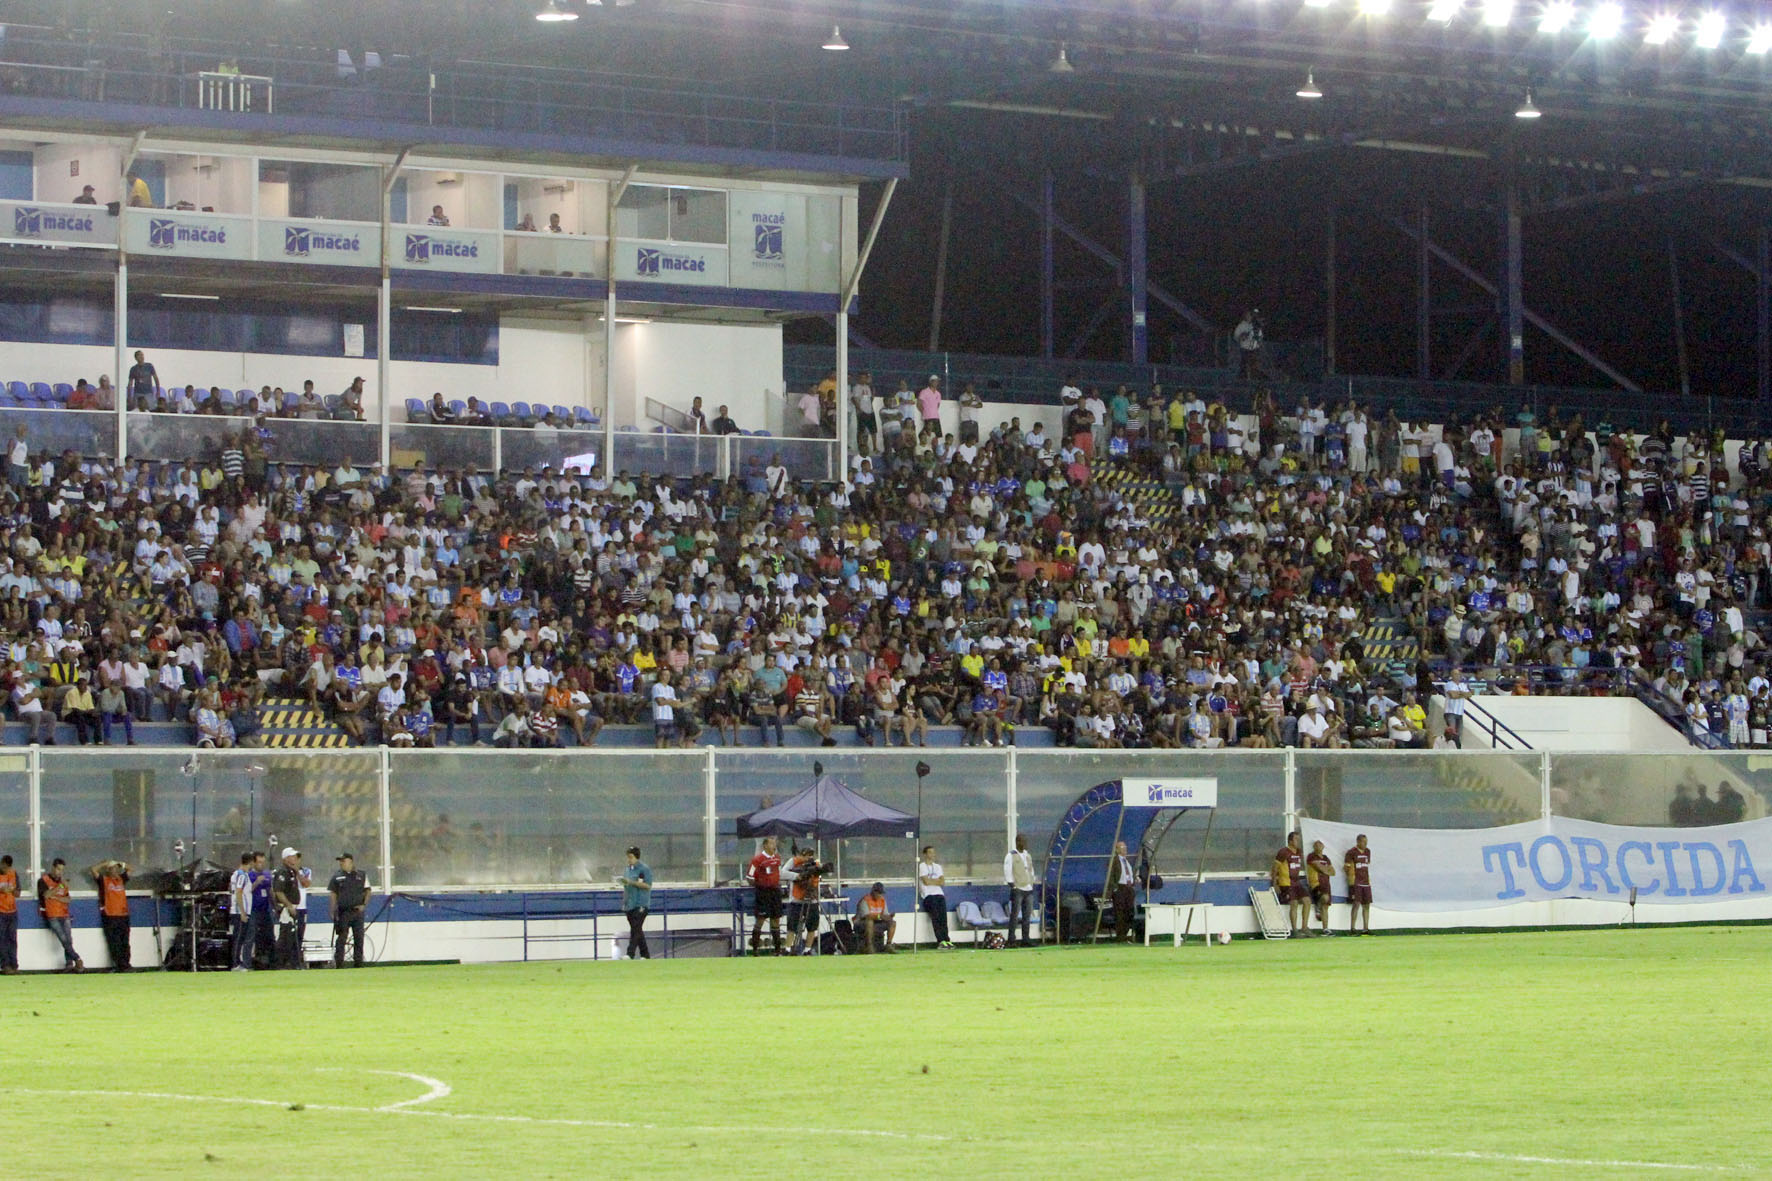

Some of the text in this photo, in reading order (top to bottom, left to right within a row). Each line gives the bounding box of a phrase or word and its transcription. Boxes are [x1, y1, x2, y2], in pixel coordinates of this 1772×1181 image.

[43, 215, 93, 232] macaé
[752, 211, 785, 224] macaé
[177, 226, 226, 243] macaé
[312, 233, 360, 251] macaé
[432, 240, 478, 258] macaé
[662, 256, 705, 272] macaé
[1482, 835, 1766, 900] TORCIDA
